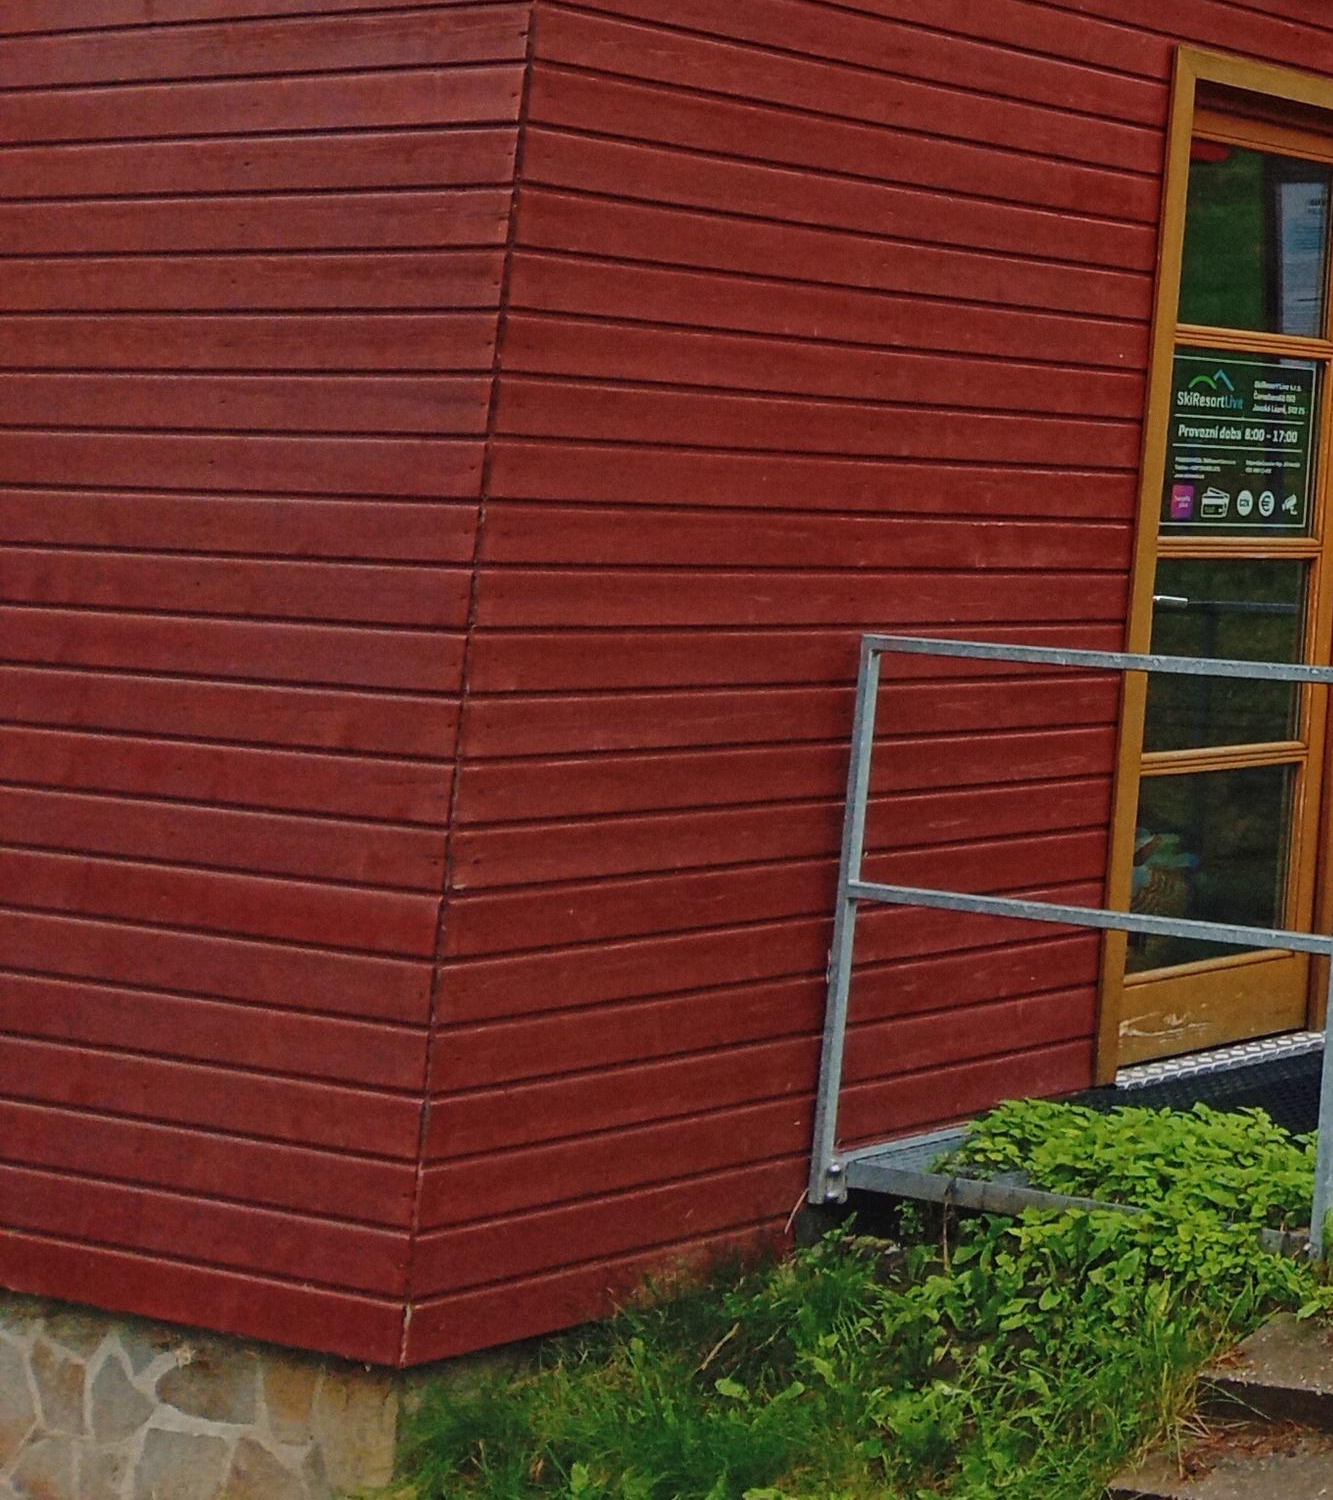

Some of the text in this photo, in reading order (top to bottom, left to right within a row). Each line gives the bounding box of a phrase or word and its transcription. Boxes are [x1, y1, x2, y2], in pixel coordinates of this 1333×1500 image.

[1178, 424, 1219, 440] Provozní
[1219, 426, 1242, 441] doba
[1244, 427, 1265, 442] 8:00
[1273, 430, 1299, 444] 17:00
